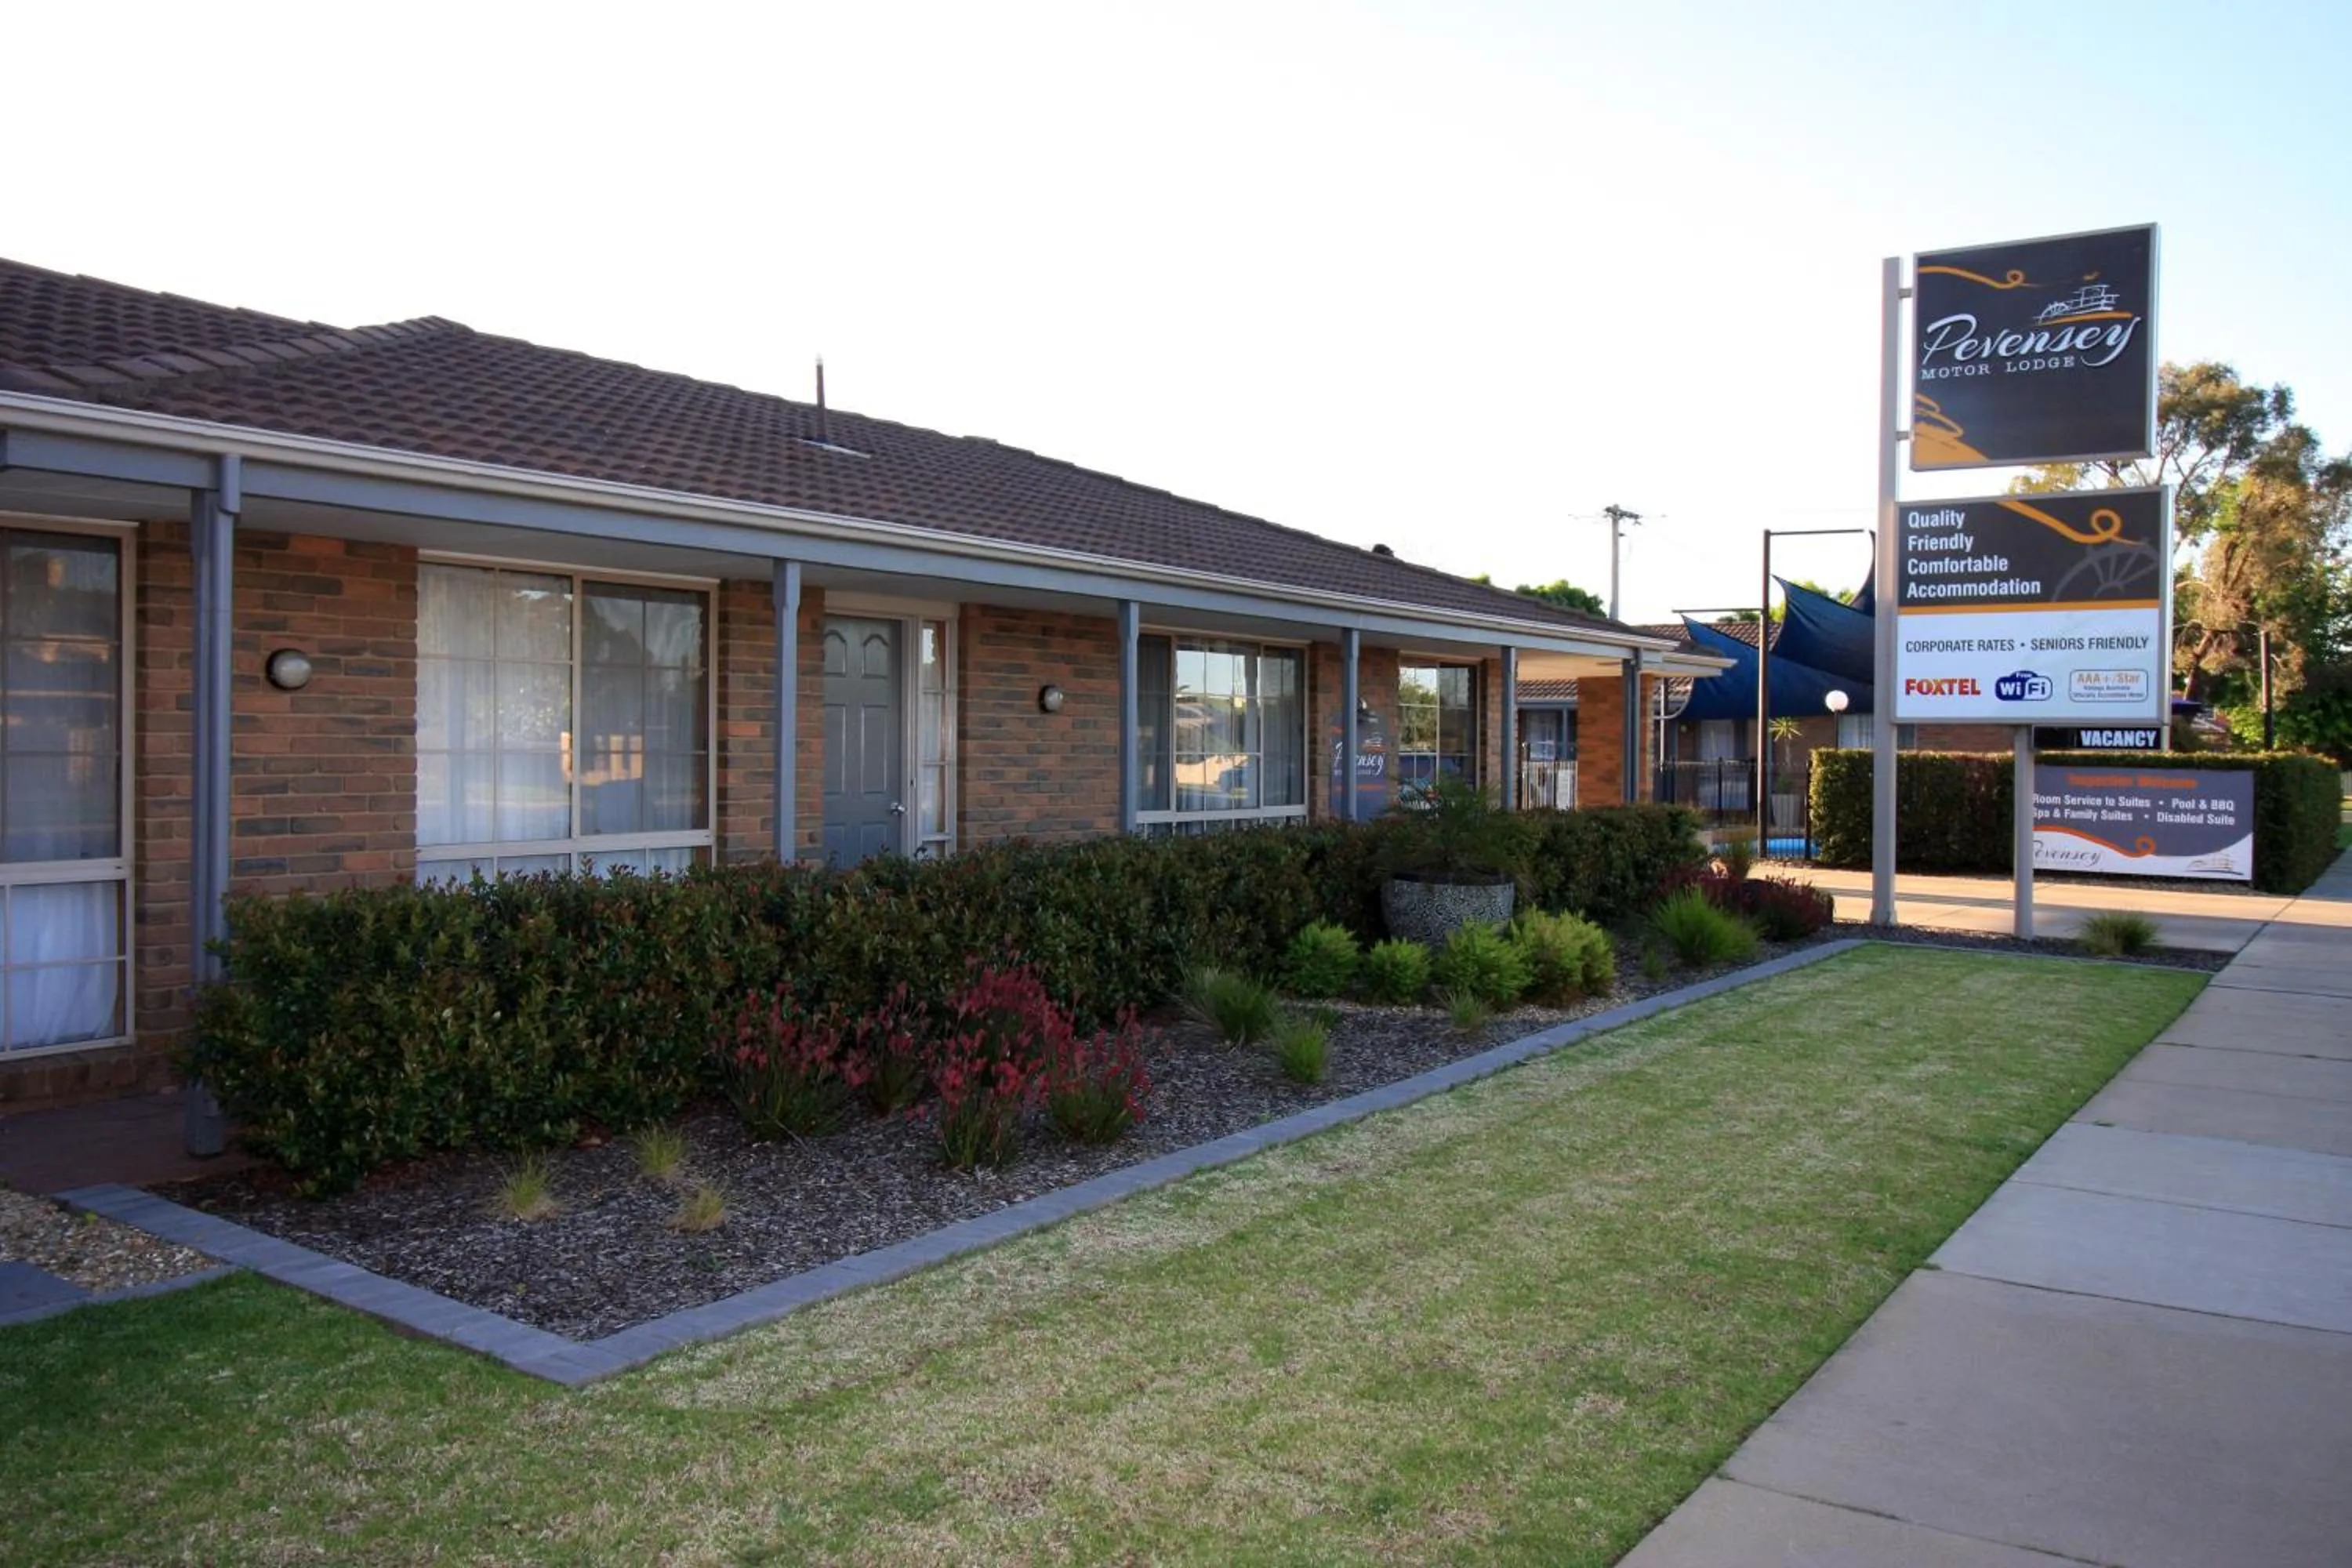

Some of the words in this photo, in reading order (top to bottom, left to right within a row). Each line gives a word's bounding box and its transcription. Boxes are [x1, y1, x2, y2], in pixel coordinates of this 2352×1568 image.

[1923, 313, 2140, 367] Pevensey
[1921, 363, 1991, 380] MOTOR
[2006, 355, 2075, 373] LODGE
[1908, 510, 1965, 530] Quality
[1907, 533, 1974, 553] Friendly
[1907, 555, 2008, 575] Comfortable
[1907, 579, 2041, 599] Accommodation
[1906, 639, 1974, 653] CORPORATE
[1977, 639, 2015, 652] RATES
[2031, 637, 2085, 651] SENIORS
[2088, 636, 2150, 650] FRIENDLY
[1905, 678, 1981, 695] FOXTEL
[2081, 730, 2157, 747] VACANCY
[2063, 794, 2102, 807] Service
[2105, 796, 2115, 806] to
[2118, 796, 2151, 808] Suites
[2172, 798, 2195, 810] Pool
[2198, 799, 2207, 810] &
[2210, 800, 2234, 811] BBQ
[2053, 808, 2061, 818] &
[2064, 809, 2097, 822] Family
[2100, 810, 2133, 821] Suites
[2157, 811, 2204, 824] Disabled
[2207, 813, 2235, 826] Suite
